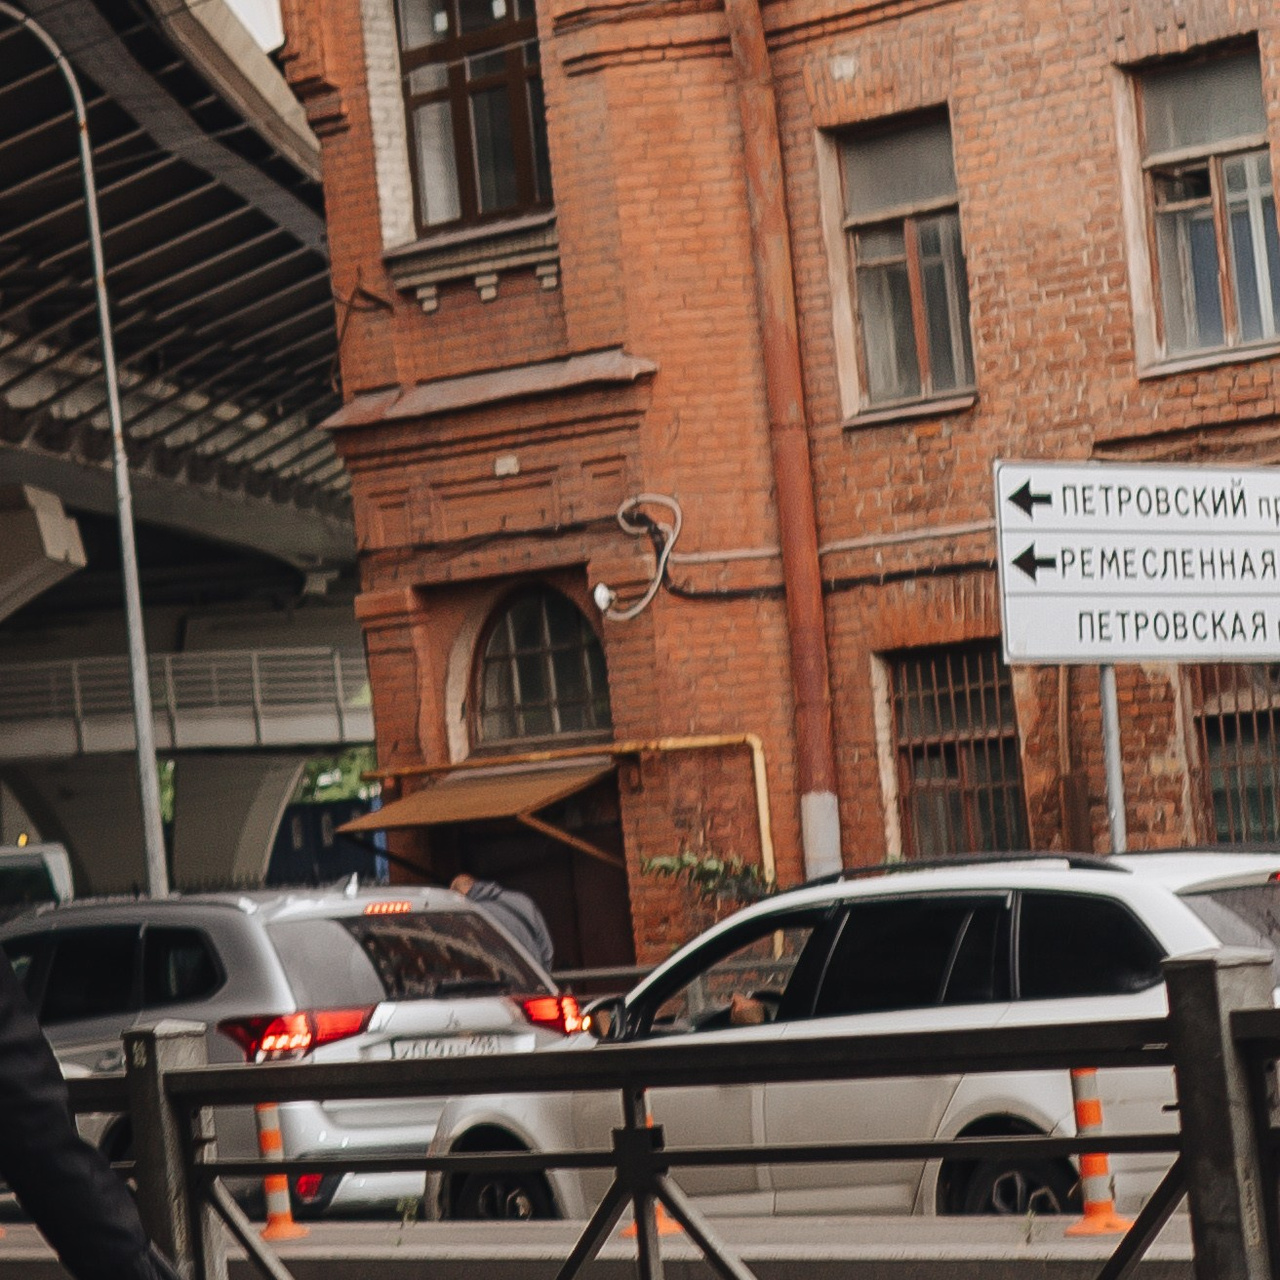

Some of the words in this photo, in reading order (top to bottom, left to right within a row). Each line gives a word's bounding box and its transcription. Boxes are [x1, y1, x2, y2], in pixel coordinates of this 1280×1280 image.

[1062, 478, 1247, 517] ПЕТРОВСКИЙ
[1060, 547, 1277, 580] РЕМЕСЛЕННАЯ
[1078, 610, 1267, 642] ПЕТРОВСКАЯ
